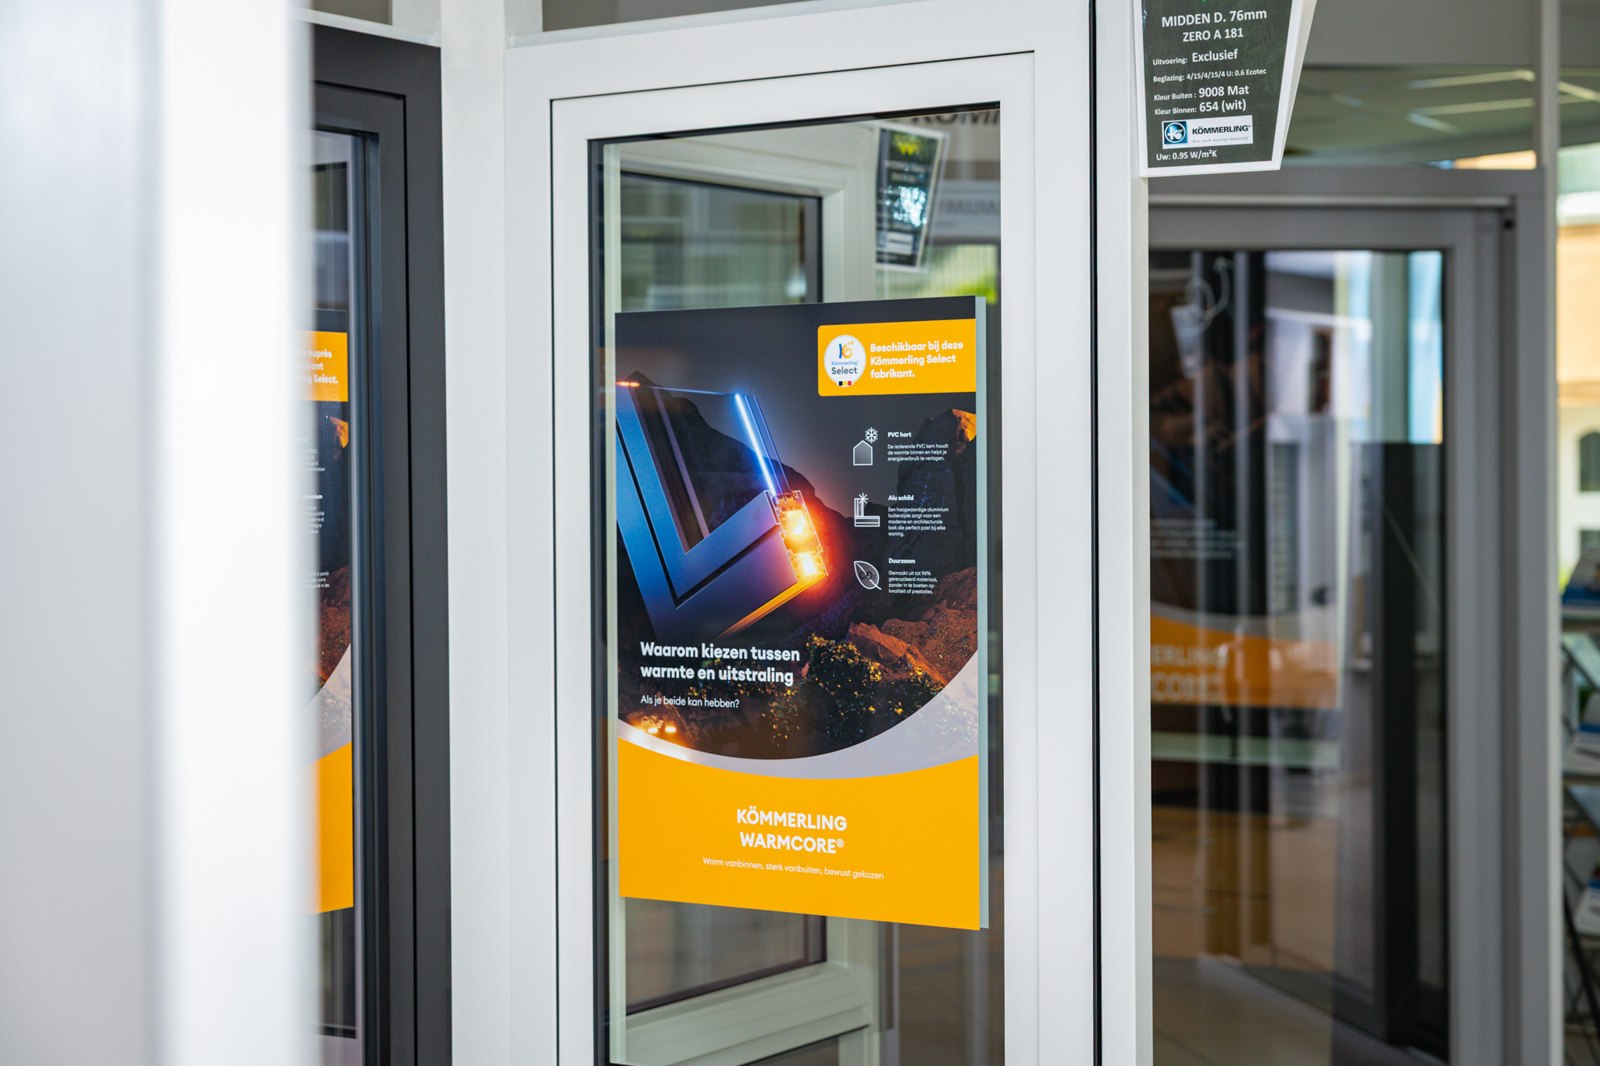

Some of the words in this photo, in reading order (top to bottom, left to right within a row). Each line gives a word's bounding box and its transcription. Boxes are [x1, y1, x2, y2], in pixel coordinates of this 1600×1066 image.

[1162, 12, 1211, 27] MIDDEN
[1214, 12, 1226, 24] D.
[1230, 9, 1267, 22] 76mm
[1182, 30, 1211, 42] ZERO
[1213, 29, 1222, 40] A
[1224, 28, 1244, 39] 181
[1153, 57, 1188, 66] Uitvoering:
[1192, 49, 1238, 63] Exclusief
[1153, 74, 1185, 83] Beglazing:
[1187, 71, 1225, 80] 4/15/4/15/4
[1172, 92, 1193, 100] Buiten
[1198, 86, 1225, 97] 9008
[1228, 84, 1250, 96] Mat
[1172, 106, 1197, 114] Binnen:
[1199, 101, 1219, 112] 654
[1222, 99, 1247, 112] (wit)
[1156, 152, 1171, 161] Uw:
[1172, 151, 1189, 160] 0.95
[1191, 149, 1218, 159] W/m²K
[870, 342, 926, 353] Beschikbaar
[928, 341, 939, 352] bij
[942, 340, 963, 350] deze
[870, 355, 924, 366] Kömmerling
[926, 354, 956, 364] Select
[832, 366, 858, 375] Select
[870, 368, 915, 379] fabrikant.
[314, 374, 338, 384] Select.
[641, 641, 698, 660] Waarom
[702, 644, 747, 660] kiezen
[751, 646, 800, 662] tussen
[641, 664, 694, 680] warmte
[698, 668, 715, 680] en
[718, 666, 794, 686] uitstraling
[641, 696, 653, 705] Als
[654, 696, 662, 707] je
[663, 696, 686, 706] beide
[688, 697, 703, 707] kan
[704, 698, 740, 709] hebben?
[736, 806, 847, 832] KÖMMERLING
[740, 831, 844, 854] WARMCORE®
[703, 856, 724, 866] Warm
[726, 858, 764, 871] vanbinnen,
[765, 862, 783, 872] sterk
[784, 864, 823, 876] vanbuiten,
[824, 867, 851, 878] bewust
[852, 870, 884, 880] gekozen
